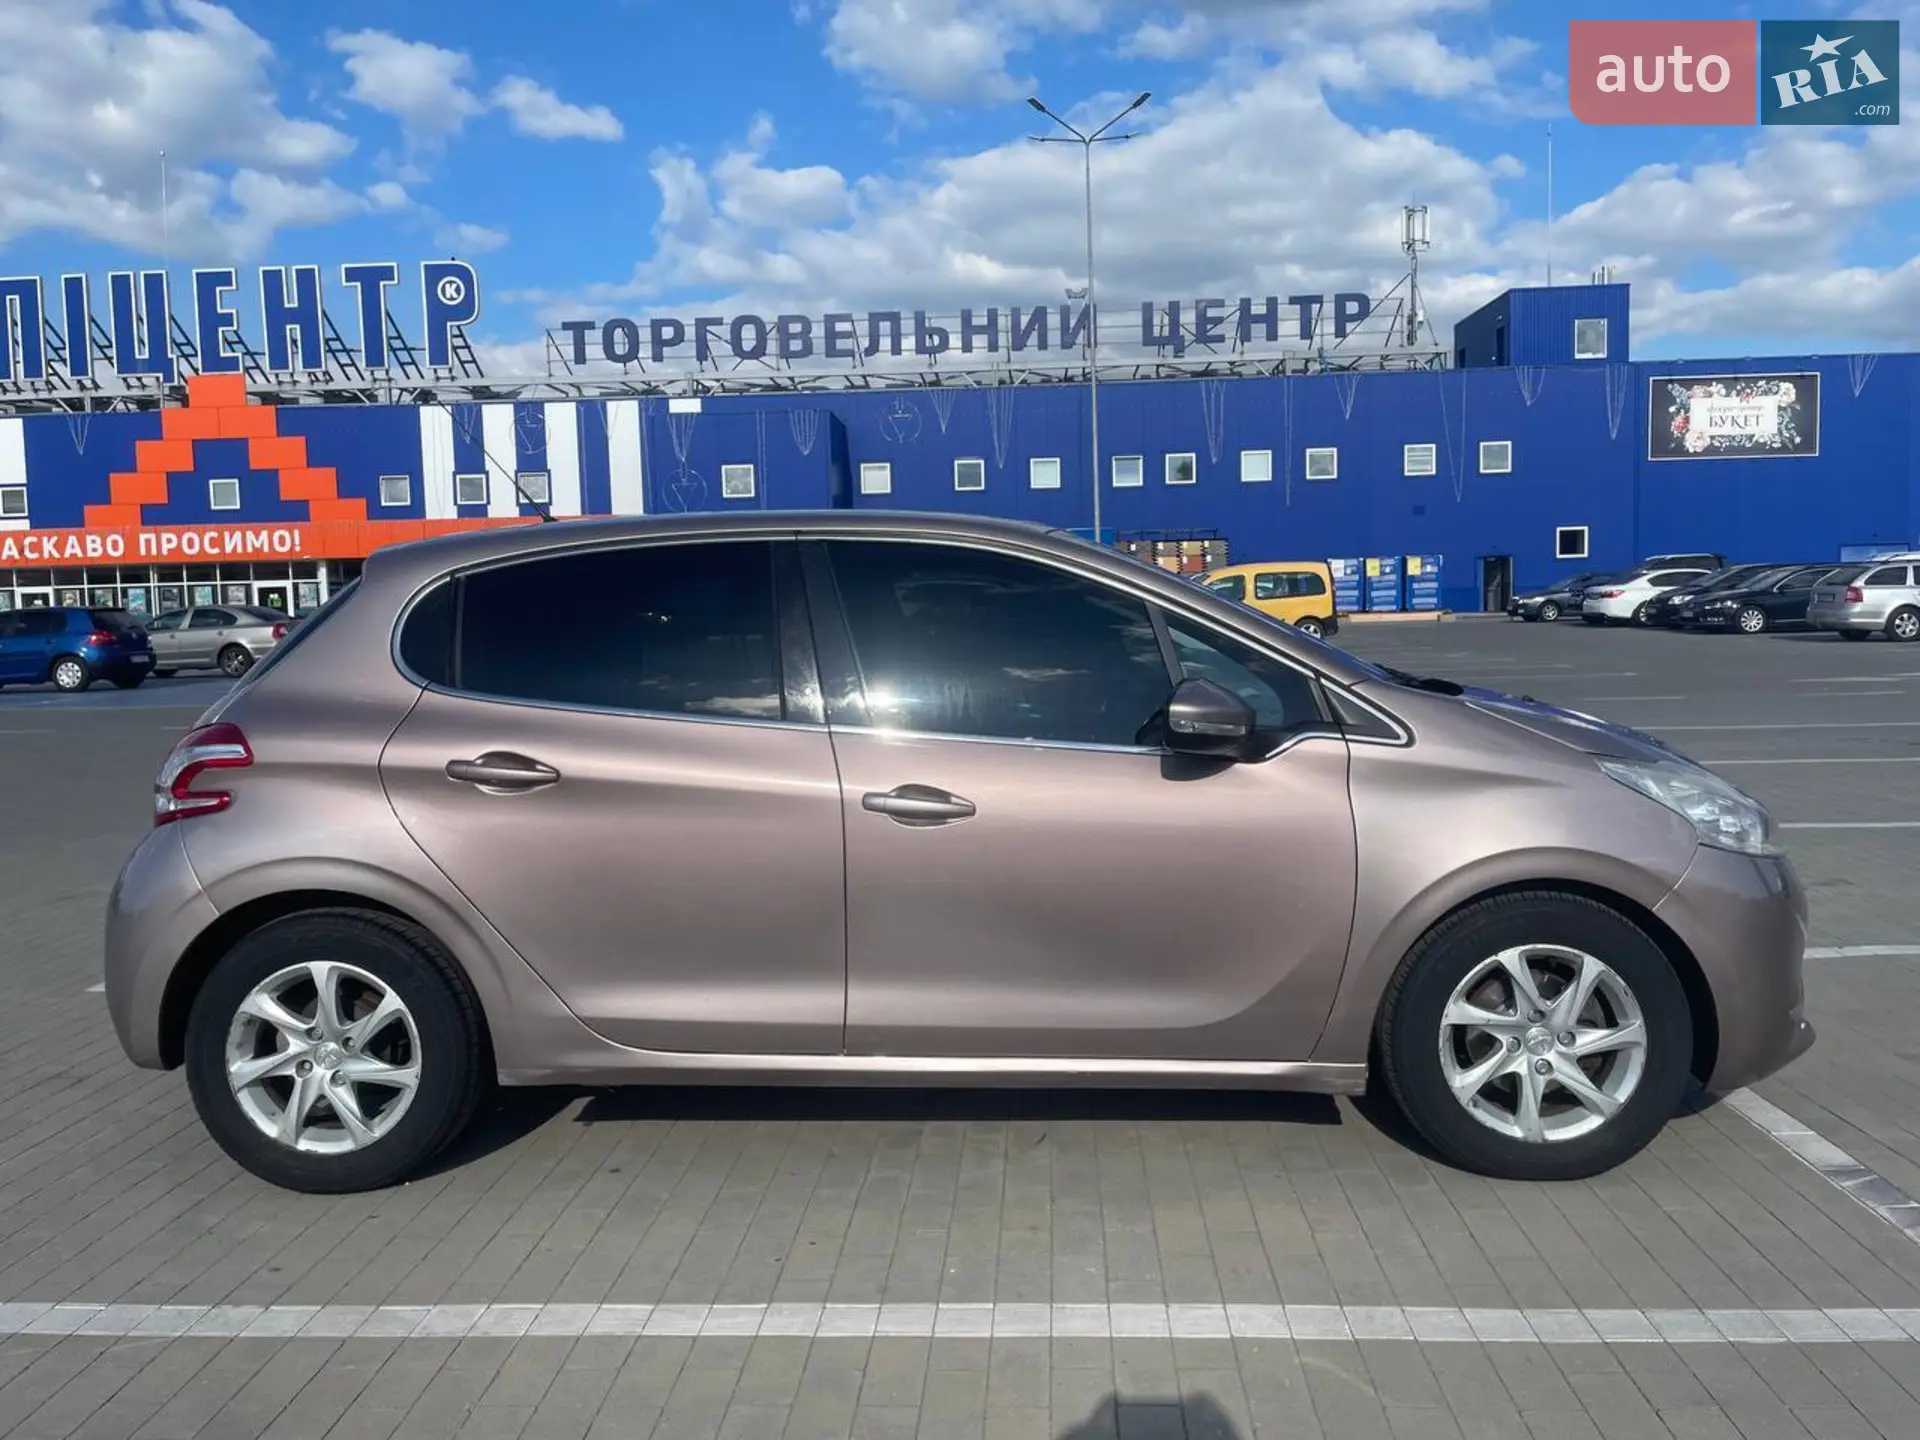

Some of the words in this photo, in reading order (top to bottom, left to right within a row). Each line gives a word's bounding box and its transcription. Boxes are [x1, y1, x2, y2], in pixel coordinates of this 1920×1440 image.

[561, 288, 1097, 366] ТОРГОВЕЛЬНИЙ
[1141, 292, 1371, 358] ЦЕНТР
[1709, 414, 1764, 430] БУКЕТ
[1, 533, 125, 560] АСКАВО
[139, 529, 301, 556] ПРОСИМО!
